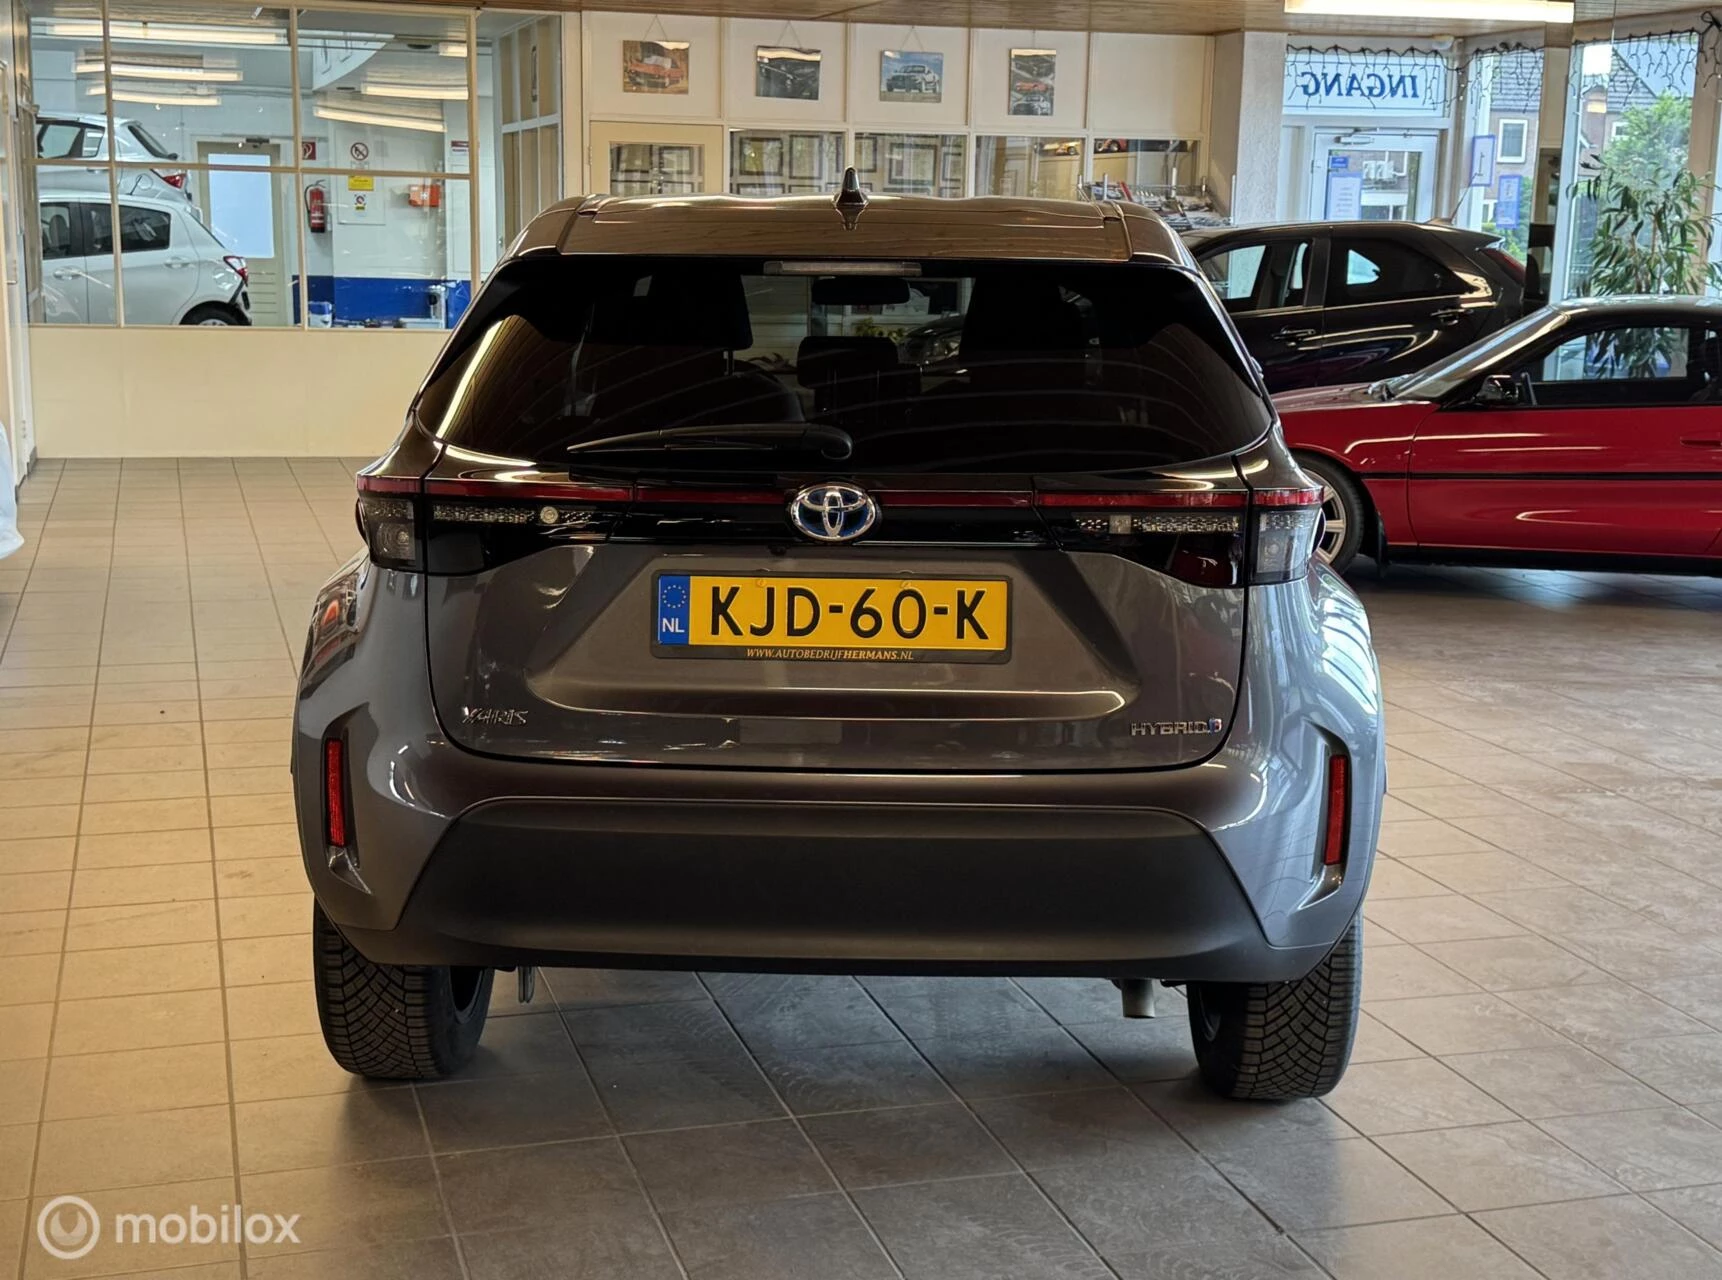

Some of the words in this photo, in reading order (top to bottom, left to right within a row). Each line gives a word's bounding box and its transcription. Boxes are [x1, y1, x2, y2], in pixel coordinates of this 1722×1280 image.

[710, 585, 989, 640] KJD-60-K
[662, 618, 685, 633] NL
[746, 648, 914, 661] WWW.AUTOBEDRIJFHERMANS.NL
[1131, 720, 1210, 736] HYBRID
